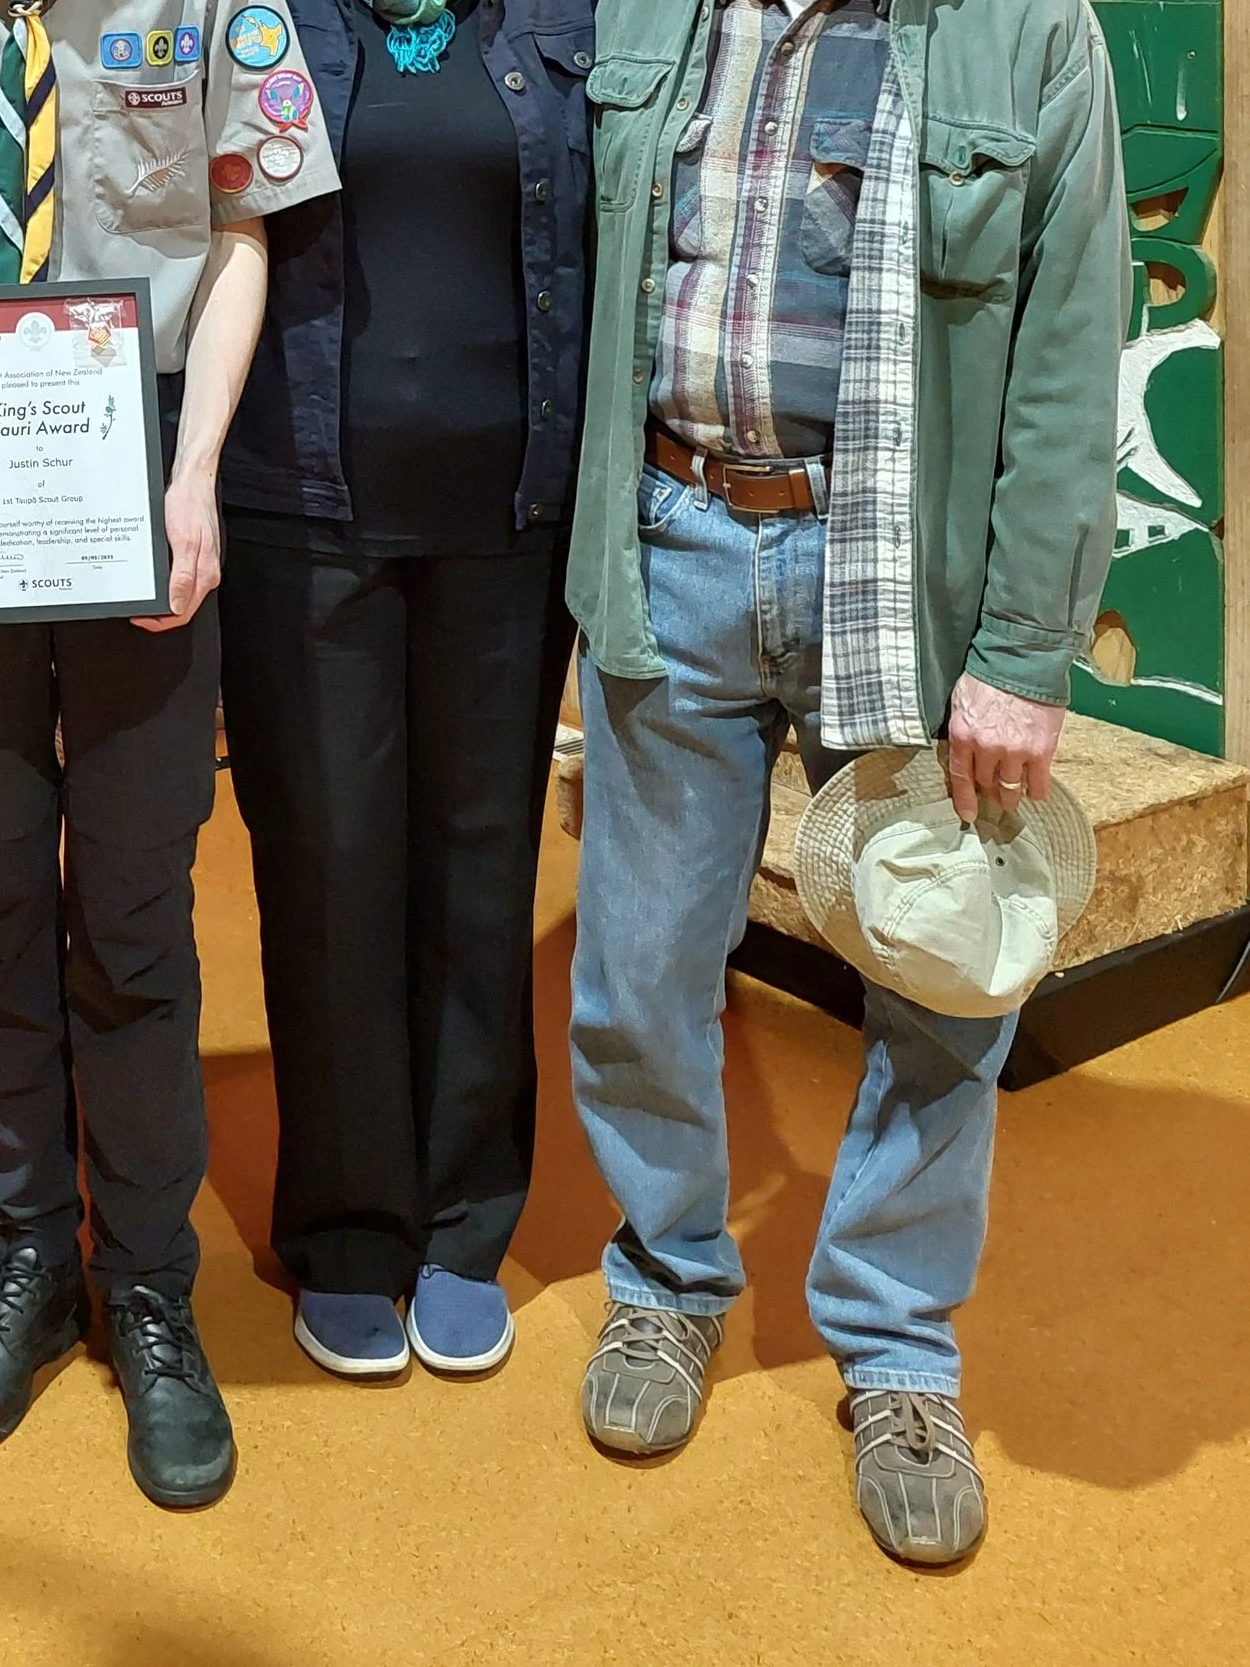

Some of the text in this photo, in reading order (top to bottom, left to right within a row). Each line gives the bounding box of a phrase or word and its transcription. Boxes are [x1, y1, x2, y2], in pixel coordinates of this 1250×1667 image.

[141, 90, 183, 102] SCOUTS
[4, 370, 44, 379] Association
[46, 369, 53, 377] of
[55, 369, 71, 377] New
[73, 368, 103, 376] Zealand
[1, 380, 29, 390] pleased
[31, 380, 38, 388] to
[40, 380, 66, 389] present
[68, 378, 80, 386] this
[42, 400, 86, 415] Scout
[36, 417, 90, 435] Award
[9, 458, 73, 469] Justin Schur
[37, 479, 45, 488] of
[61, 495, 84, 503] Group
[46, 518, 52, 526] of
[98, 516, 122, 524] highest
[49, 527, 82, 536] significant
[84, 526, 99, 534] level
[110, 525, 139, 534] personal
[32, 578, 72, 588] SCOUTS
